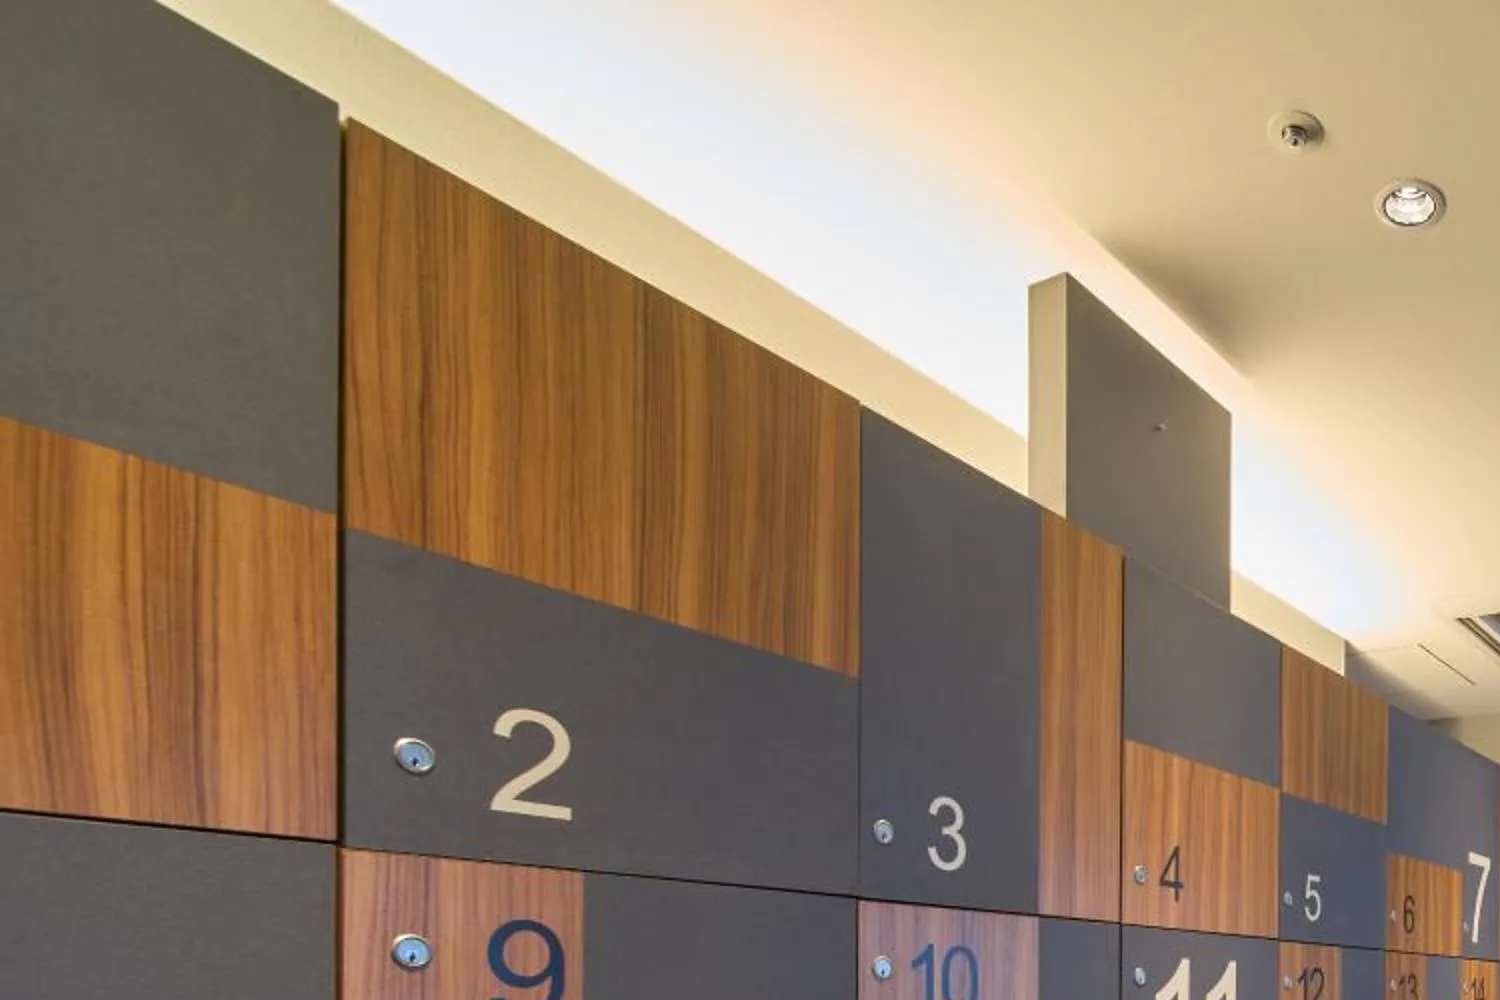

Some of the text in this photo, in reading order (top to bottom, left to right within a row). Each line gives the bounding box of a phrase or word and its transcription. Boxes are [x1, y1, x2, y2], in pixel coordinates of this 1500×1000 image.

[490, 708, 573, 822] 2
[927, 796, 966, 871] 3
[1159, 845, 1184, 902] 4
[1304, 874, 1321, 922] 5
[1468, 852, 1491, 943] 7
[1403, 896, 1415, 934] 6
